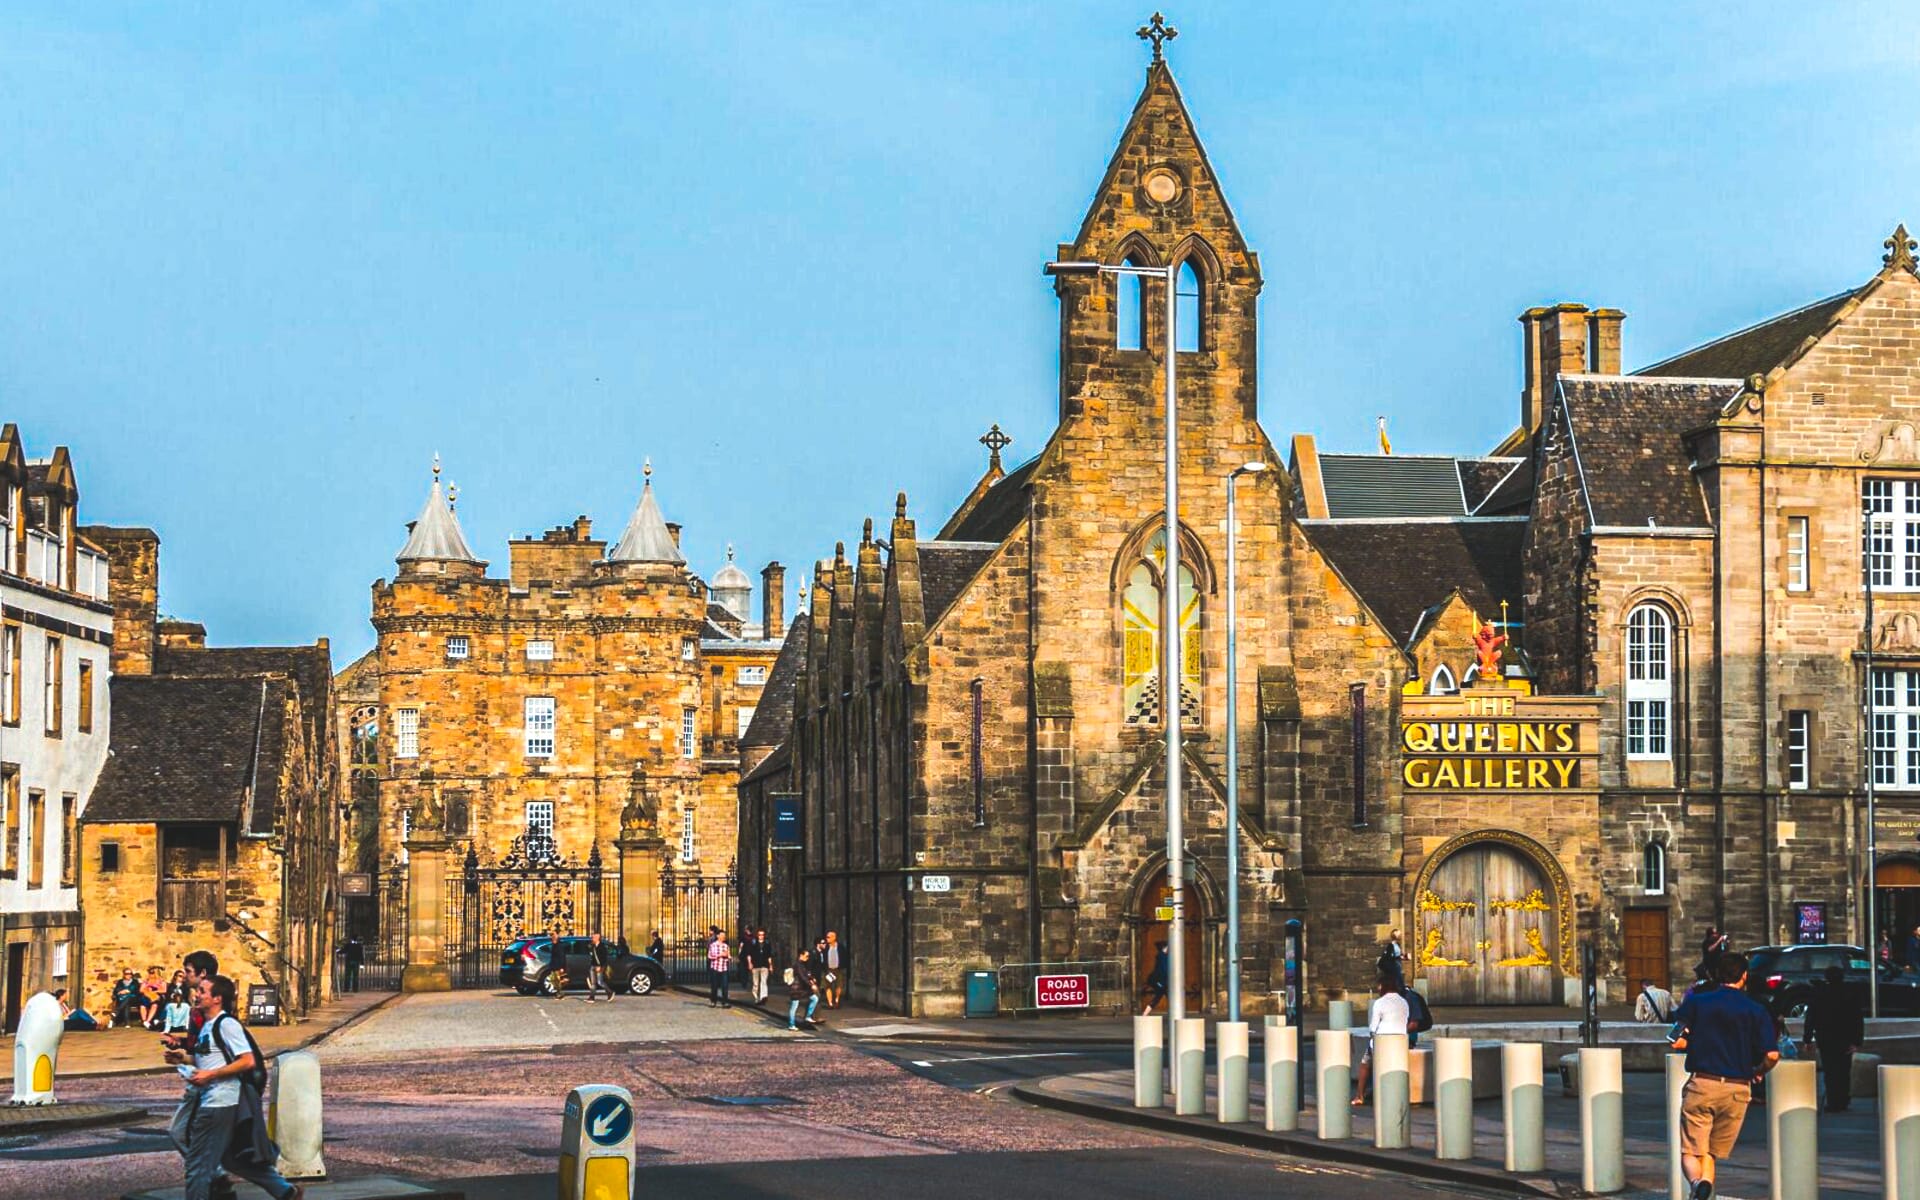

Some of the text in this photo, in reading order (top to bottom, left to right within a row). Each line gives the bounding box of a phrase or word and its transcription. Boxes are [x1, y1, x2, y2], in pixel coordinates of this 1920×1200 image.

[1465, 697, 1515, 716] THE
[1404, 722, 1574, 752] QUEEN'S
[1403, 758, 1577, 788] GALLERY
[1047, 979, 1078, 989] ROAD
[1040, 991, 1085, 1002] CLOSED
